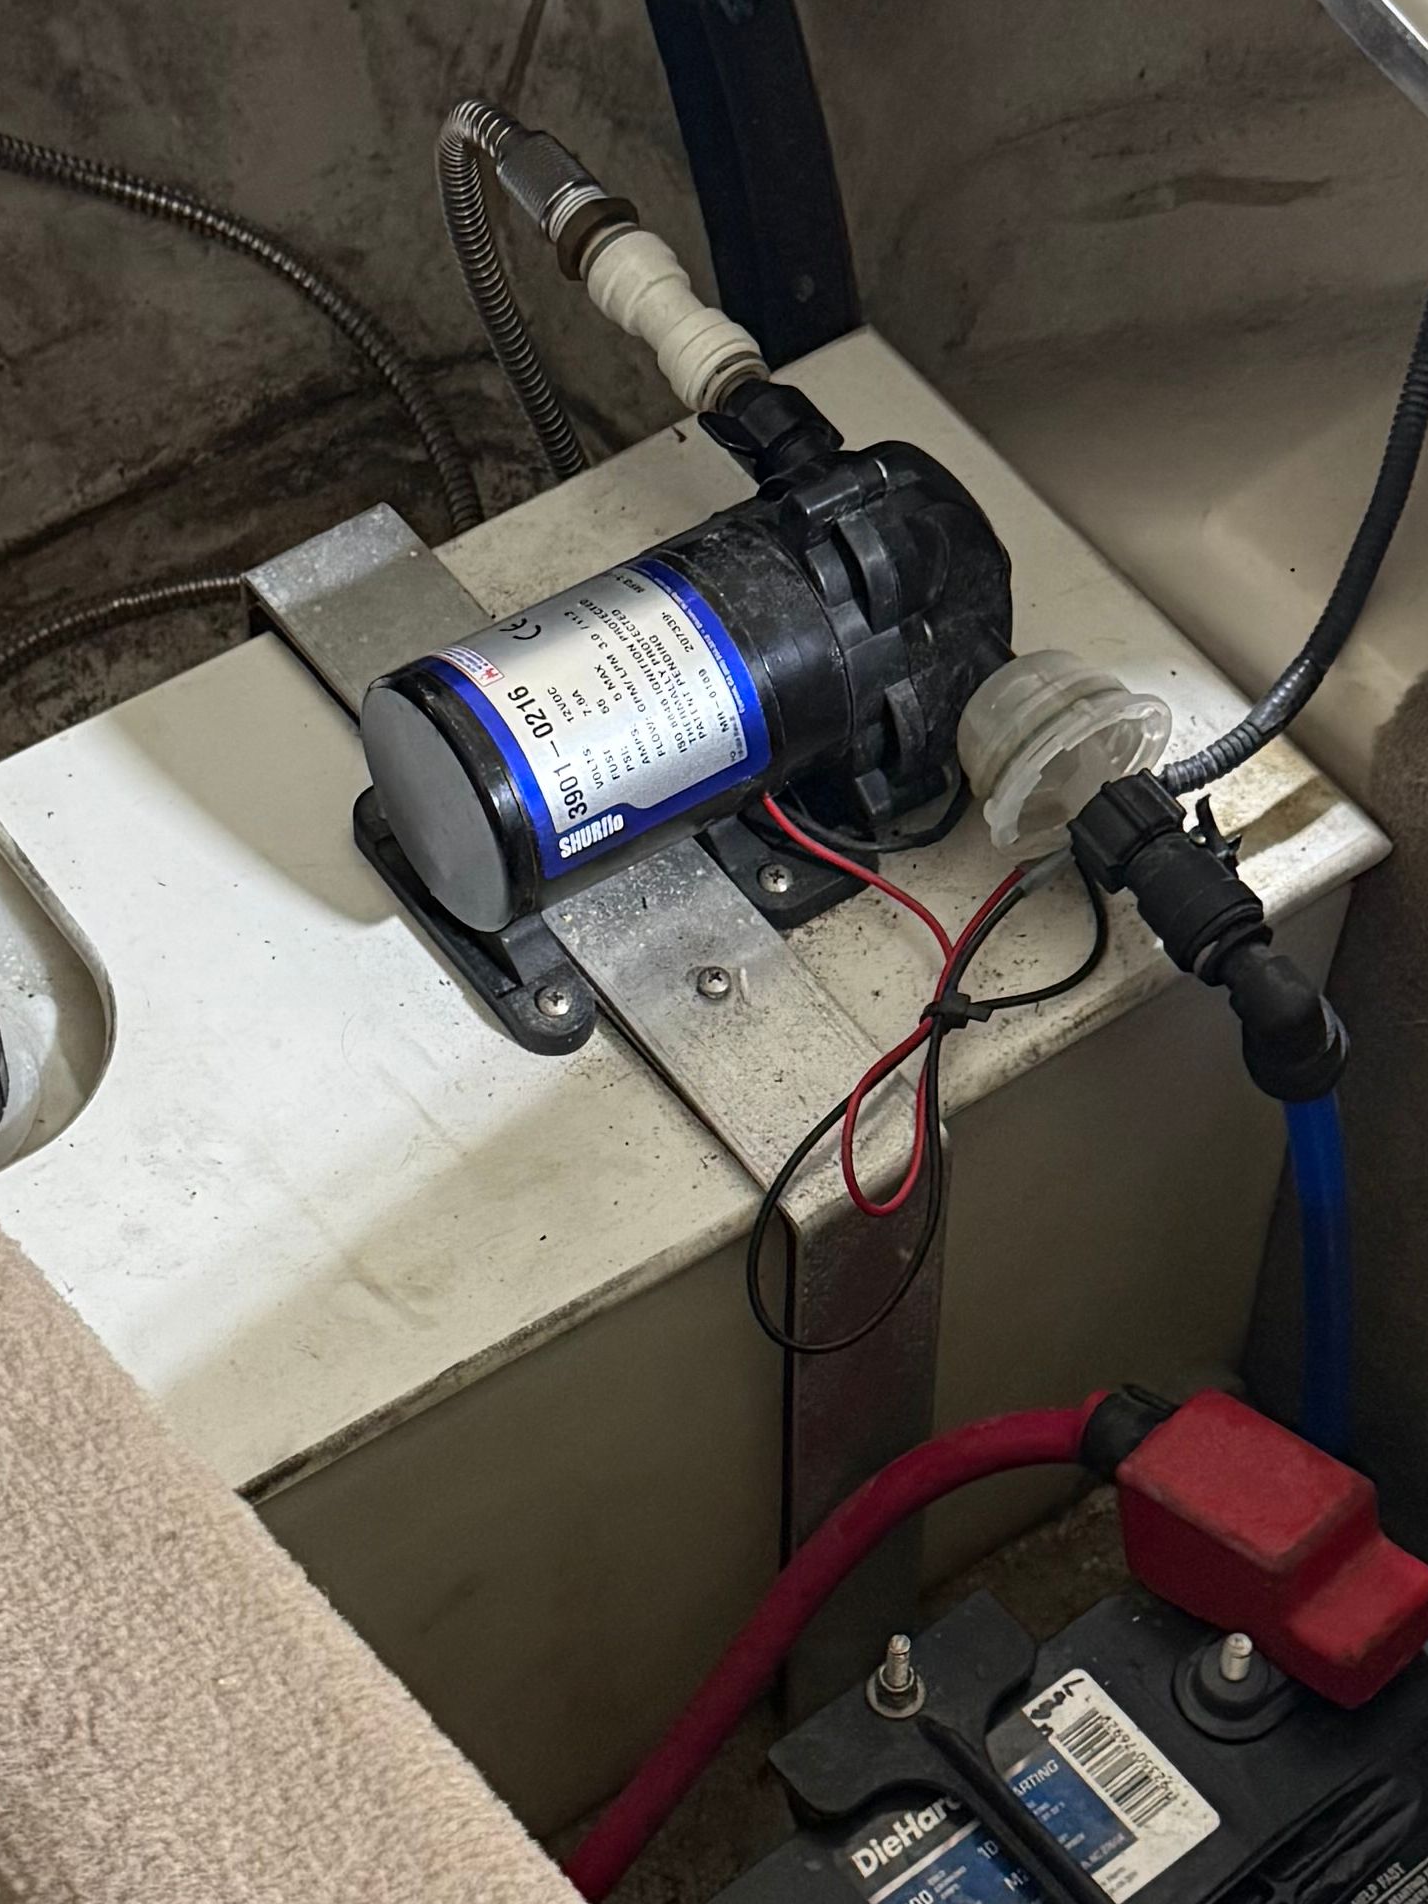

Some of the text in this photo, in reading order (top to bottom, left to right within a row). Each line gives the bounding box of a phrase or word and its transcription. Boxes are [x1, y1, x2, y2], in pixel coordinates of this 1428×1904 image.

[611, 606, 661, 666] PROTECTED
[648, 632, 686, 687] PENDING
[593, 663, 615, 691] MAX
[626, 642, 663, 696] IGNITION
[673, 731, 688, 753] ISO
